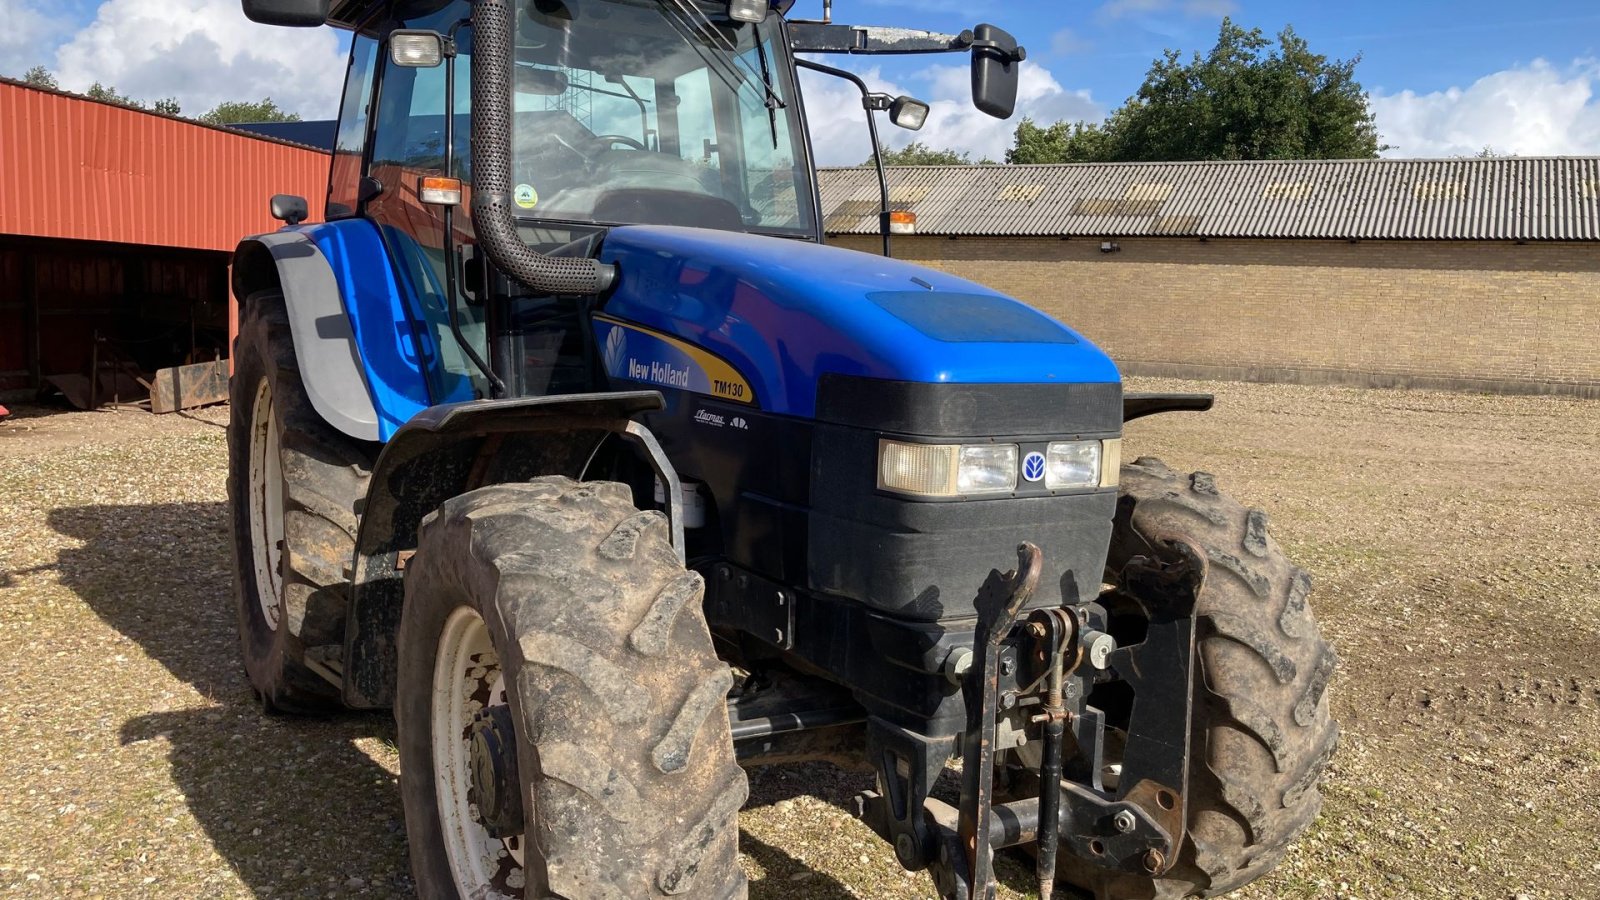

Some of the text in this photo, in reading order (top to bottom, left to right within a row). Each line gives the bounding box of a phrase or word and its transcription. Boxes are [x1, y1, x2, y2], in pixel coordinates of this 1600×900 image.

[628, 358, 689, 387] New Holland
[713, 380, 743, 397] TM130
